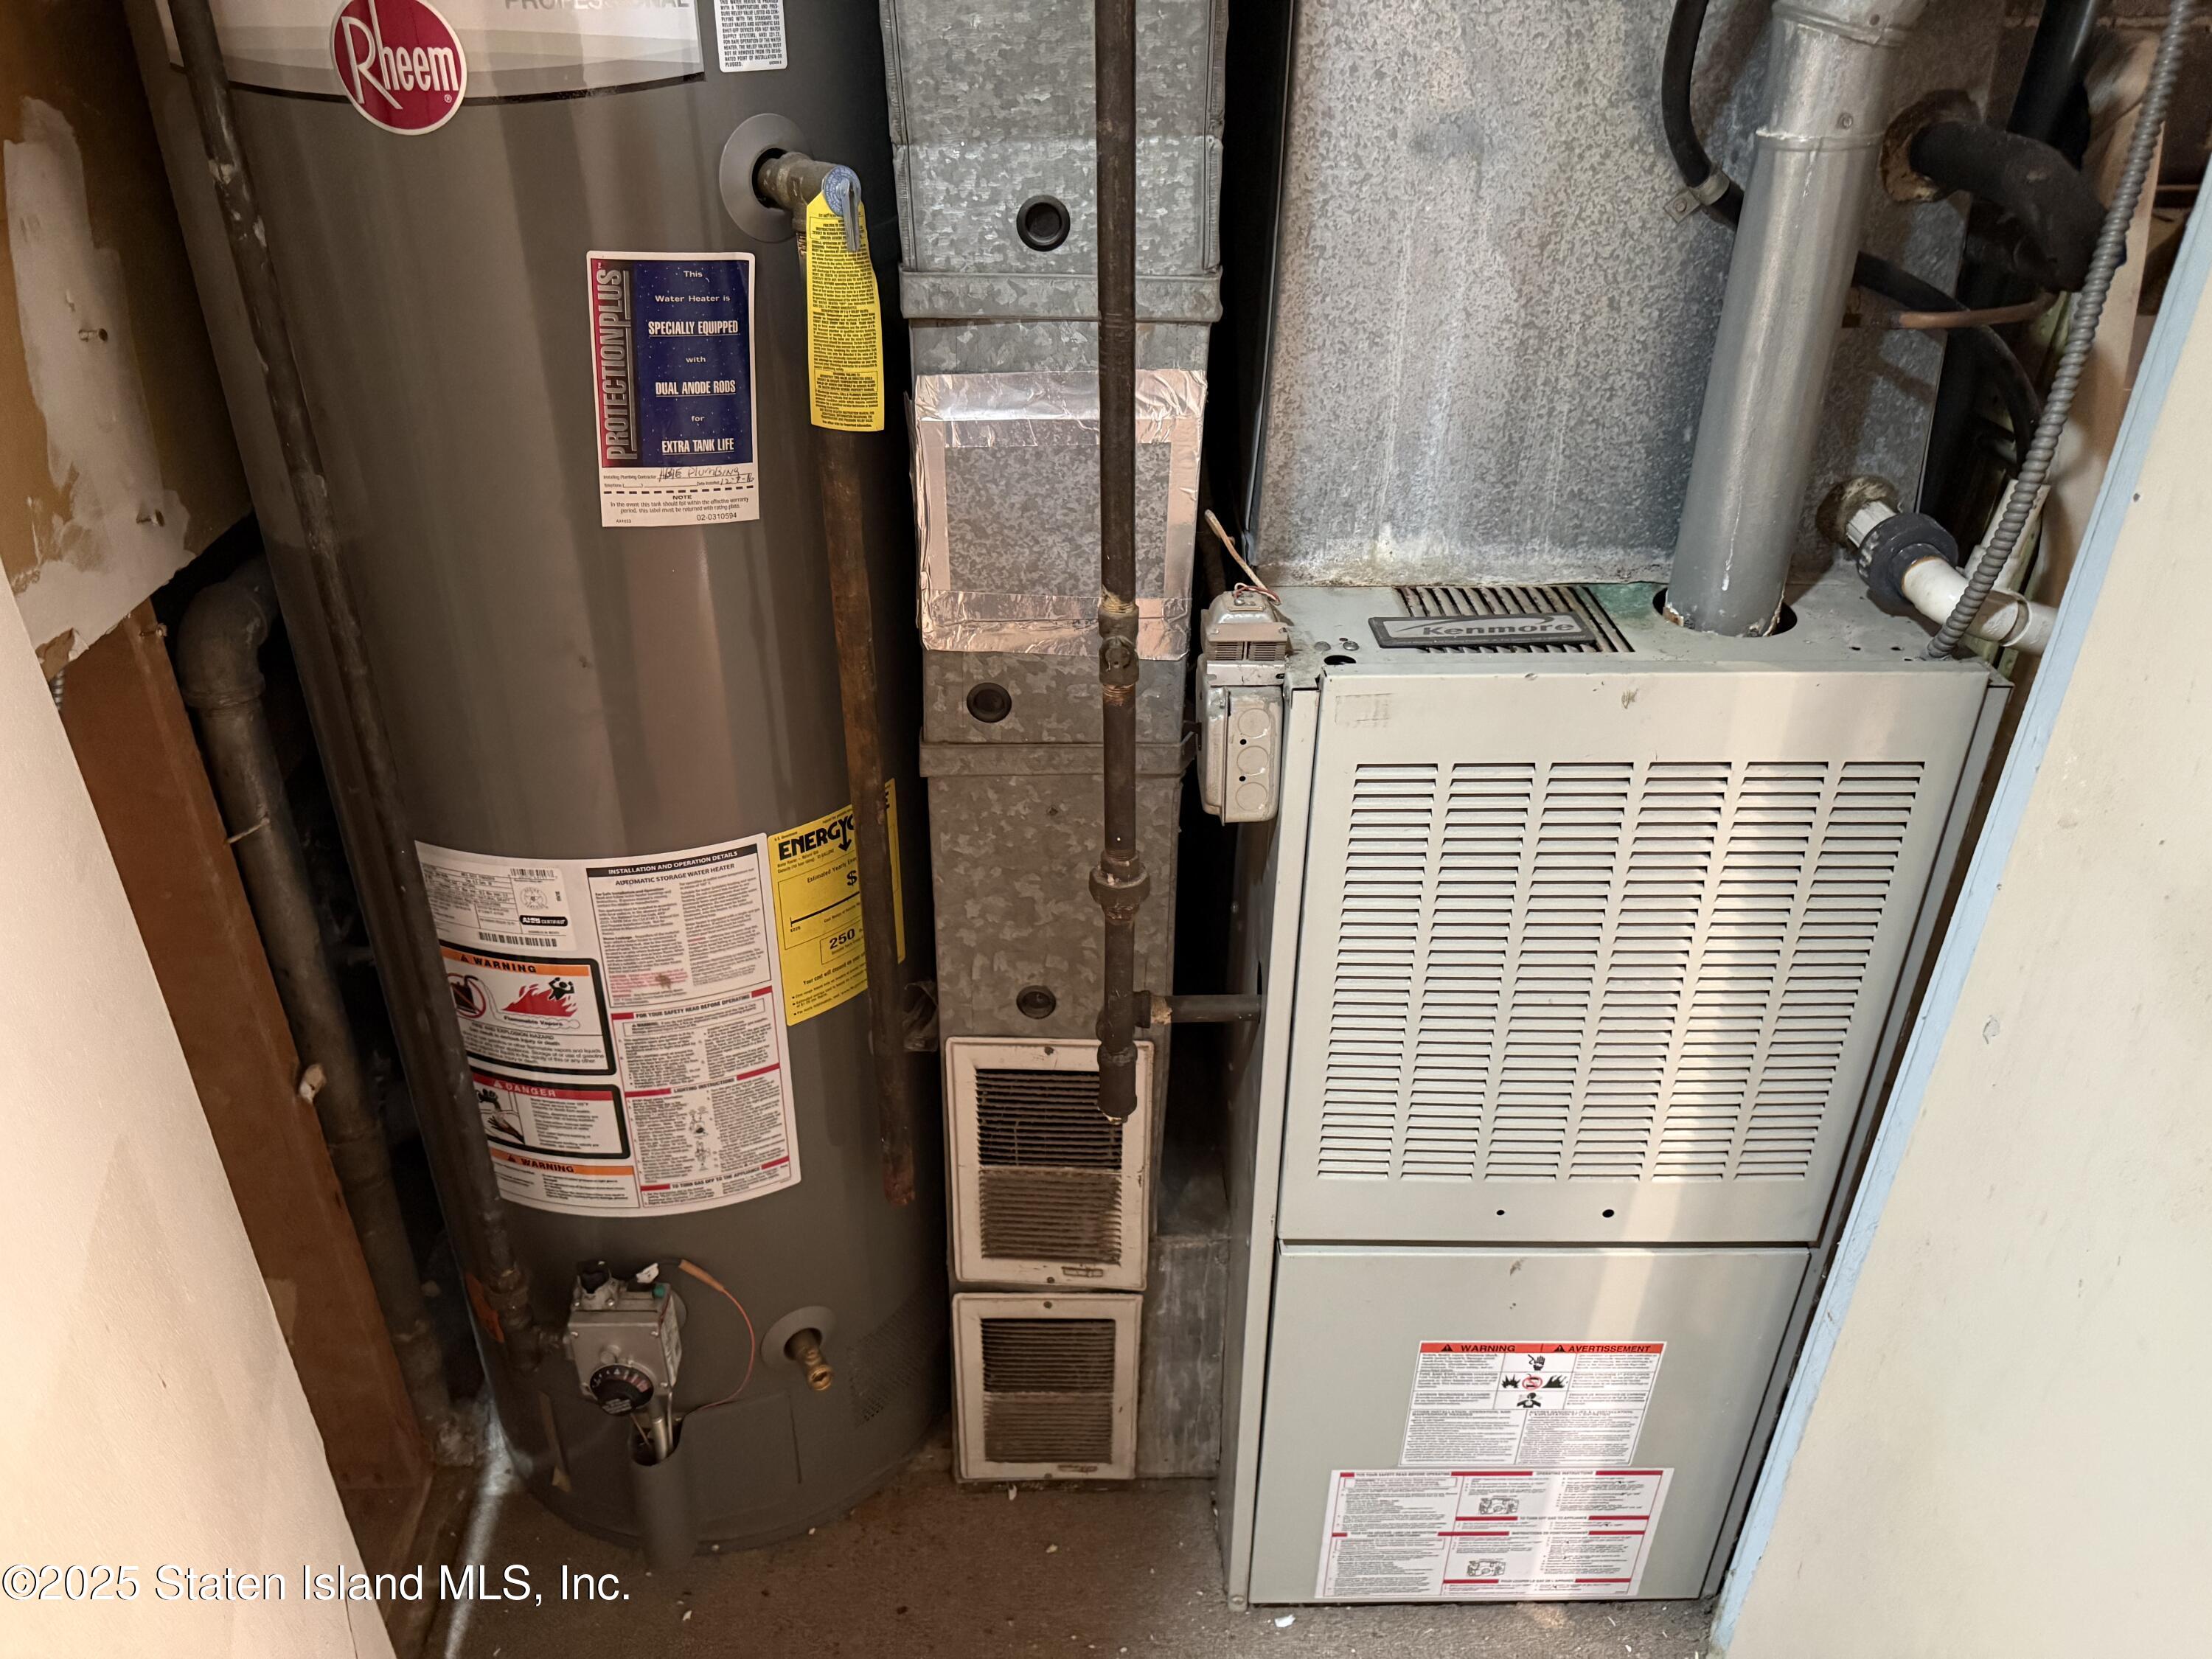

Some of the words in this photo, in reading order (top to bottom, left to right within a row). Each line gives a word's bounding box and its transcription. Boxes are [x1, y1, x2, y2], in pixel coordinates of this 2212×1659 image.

[341, 0, 459, 109] Rheem
[648, 321, 695, 335] SPECIALLY
[698, 320, 738, 335] EQUIPPED
[655, 381, 678, 395] DUAL
[682, 380, 711, 395] ANODE
[713, 380, 736, 394] RODS
[662, 439, 689, 453] EXTRA
[692, 439, 715, 452] TANK
[717, 438, 734, 451] LIFE
[1422, 622, 1575, 636] Kenmore
[608, 864, 656, 875] INSTALLATION
[658, 862, 672, 871] AND
[673, 856, 712, 869] OPERATION
[712, 851, 738, 862] DETAILS
[615, 876, 655, 886] AUTOMATIC
[655, 872, 687, 882] STORAGE
[687, 868, 709, 877] WATER
[710, 863, 735, 874] HEATER
[807, 868, 832, 883] Estimated
[832, 861, 847, 874] Yearly
[846, 870, 858, 886] $
[829, 928, 855, 950] 250
[473, 956, 537, 973] WARNING
[700, 1001, 720, 1010] BEFORE
[722, 995, 750, 1005] OPERATING
[505, 1083, 556, 1098] DANGER
[673, 1084, 698, 1093] LIGHTING
[698, 1078, 735, 1090] INSTRUCTIONS
[521, 1158, 574, 1173] WARNING
